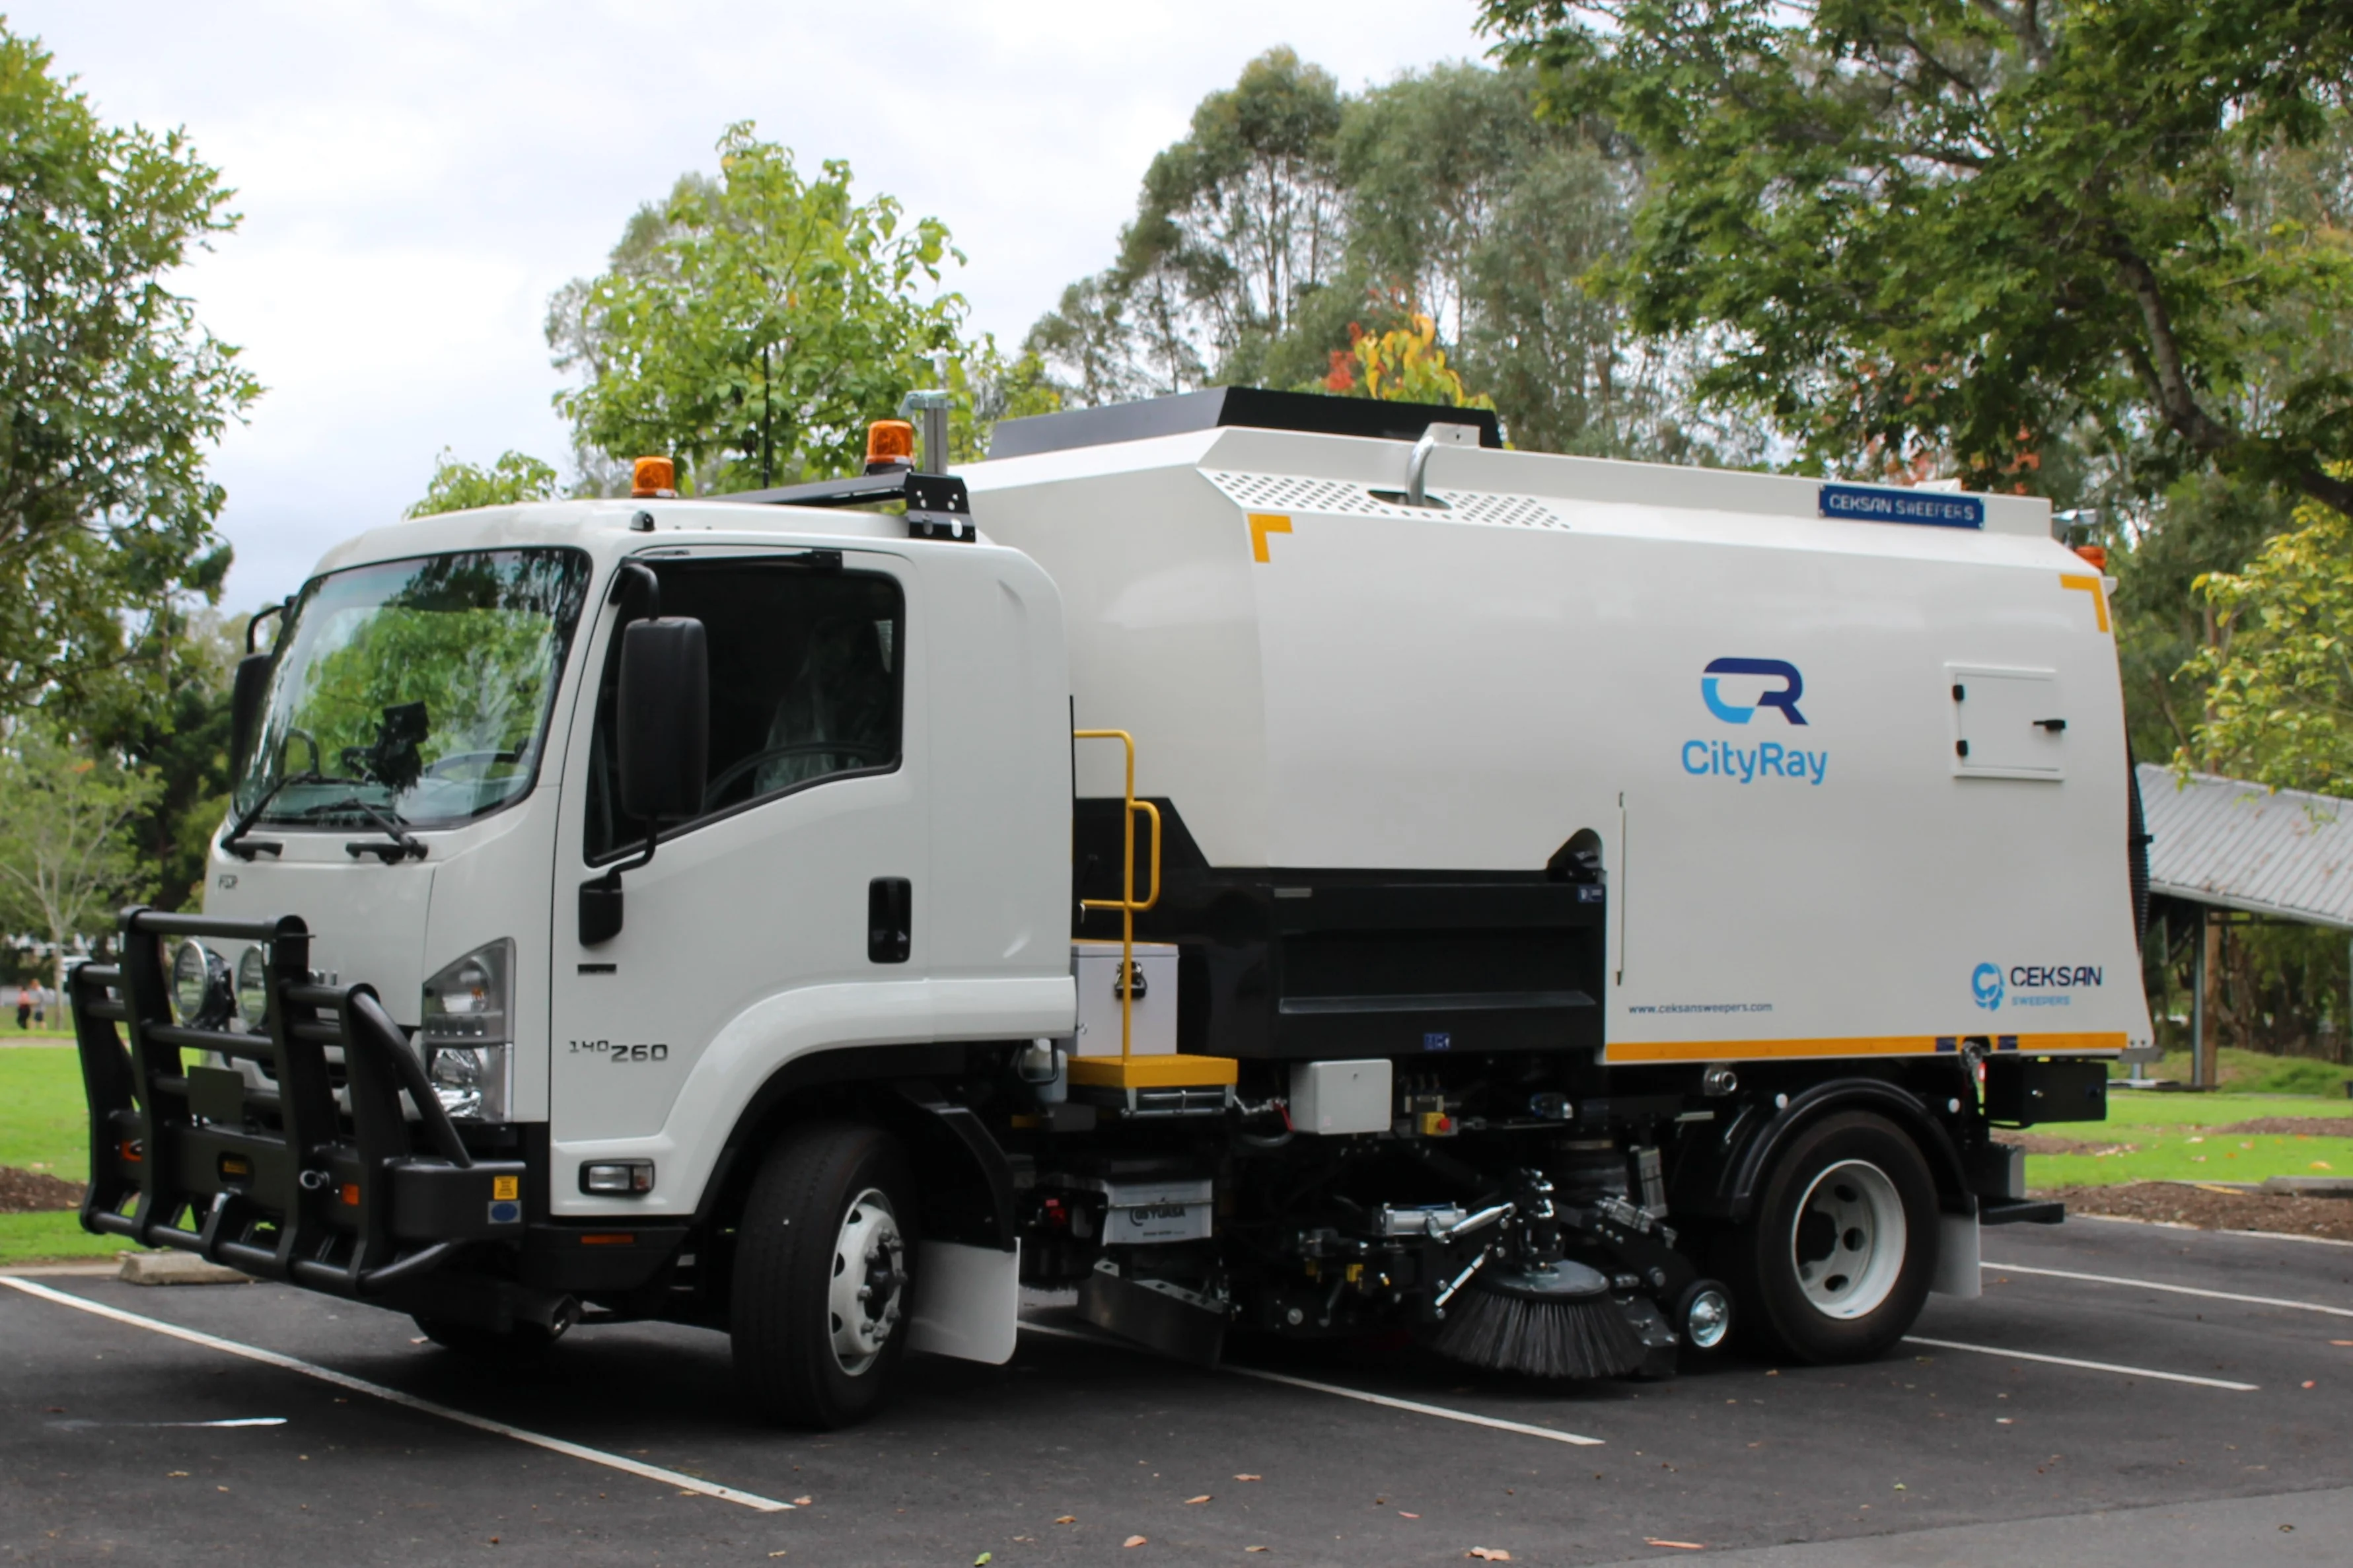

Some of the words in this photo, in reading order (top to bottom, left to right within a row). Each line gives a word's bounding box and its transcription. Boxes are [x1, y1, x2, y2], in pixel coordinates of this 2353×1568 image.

[1829, 493, 1893, 514] CEKSAN
[1681, 739, 1828, 786] CityRay
[2010, 966, 2103, 987] CEKSAN
[1628, 1002, 1774, 1015] www.ceksansweepers.com
[2011, 995, 2071, 1007] SWEEPERS
[569, 1040, 608, 1053] 140
[610, 1044, 669, 1063] 260
